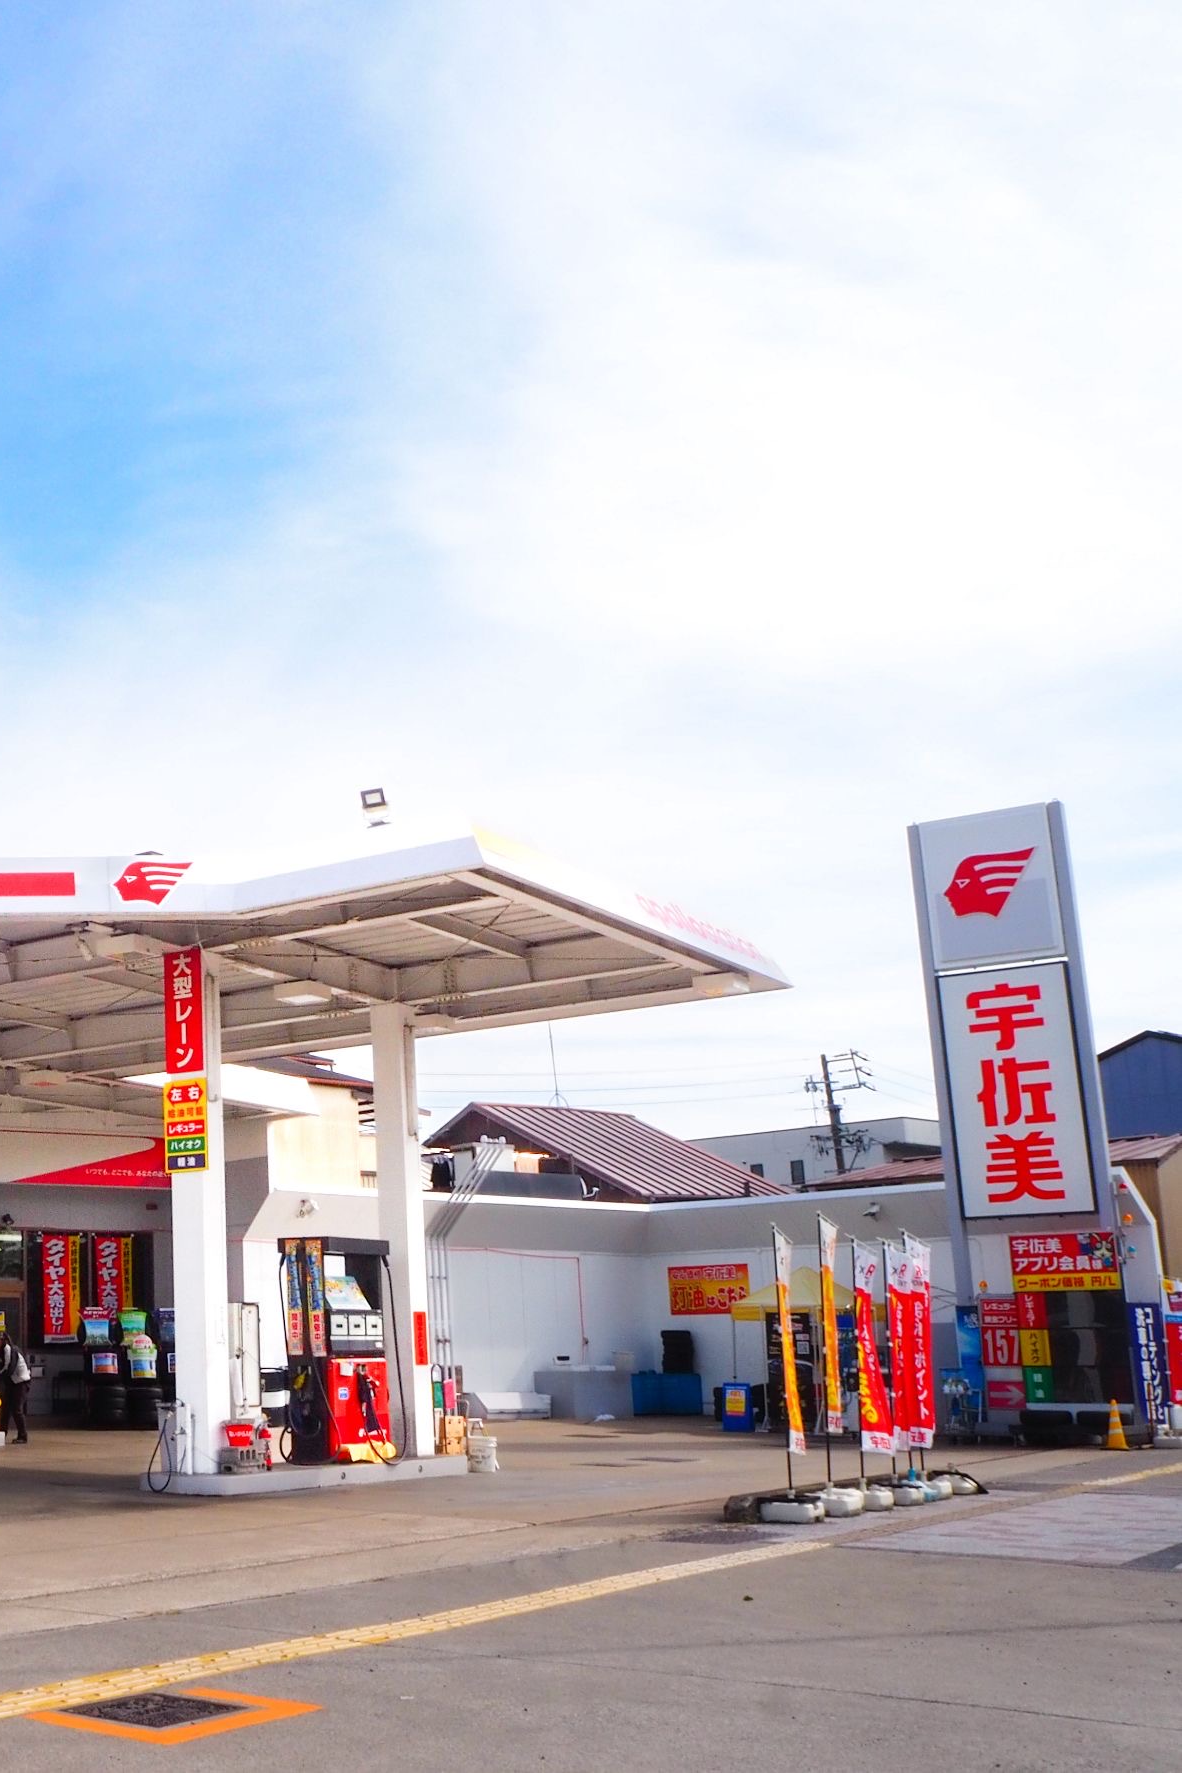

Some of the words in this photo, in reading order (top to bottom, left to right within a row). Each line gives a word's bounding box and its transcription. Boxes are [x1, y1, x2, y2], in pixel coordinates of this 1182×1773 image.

[172, 953, 194, 1069] 大型レーン
[965, 983, 1066, 1203] 宇佐美
[168, 1123, 203, 1134] レギュラー
[171, 1140, 201, 1150] ハイオク
[1012, 1238, 1062, 1254] 宇佐美
[1014, 1255, 1103, 1272] アプリ会員様
[1018, 1276, 1085, 1289] クーポン価格
[984, 1329, 1019, 1364] 157
[1029, 1333, 1040, 1363] ハイオク
